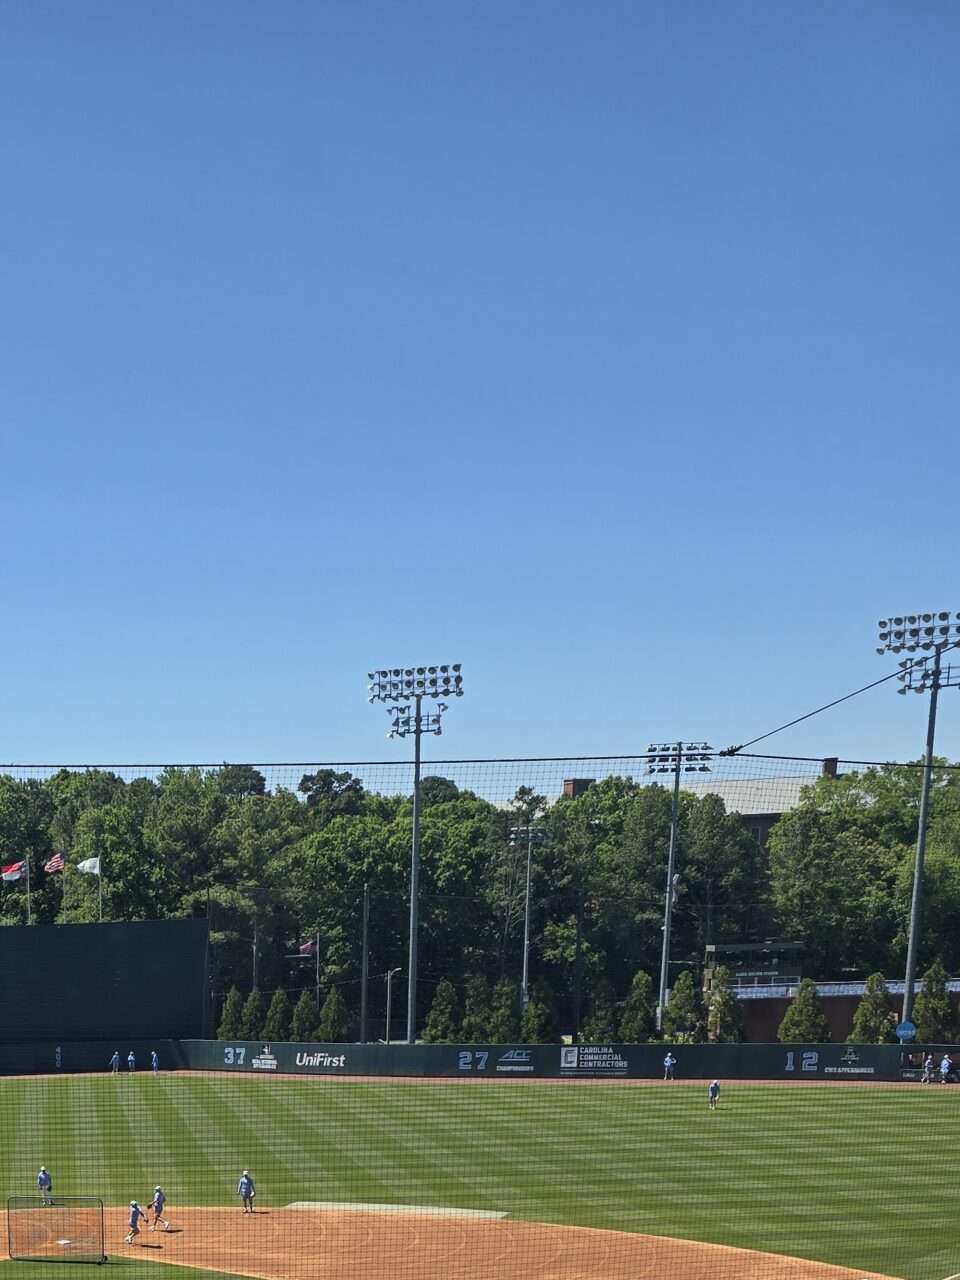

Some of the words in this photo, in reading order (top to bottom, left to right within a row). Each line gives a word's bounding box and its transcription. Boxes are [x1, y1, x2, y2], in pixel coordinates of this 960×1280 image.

[224, 1047, 246, 1065] 37
[296, 1052, 346, 1067] UniFirst
[459, 1051, 489, 1070] 27
[502, 1050, 532, 1059] ACC
[580, 1060, 628, 1068] CONTRACTORS
